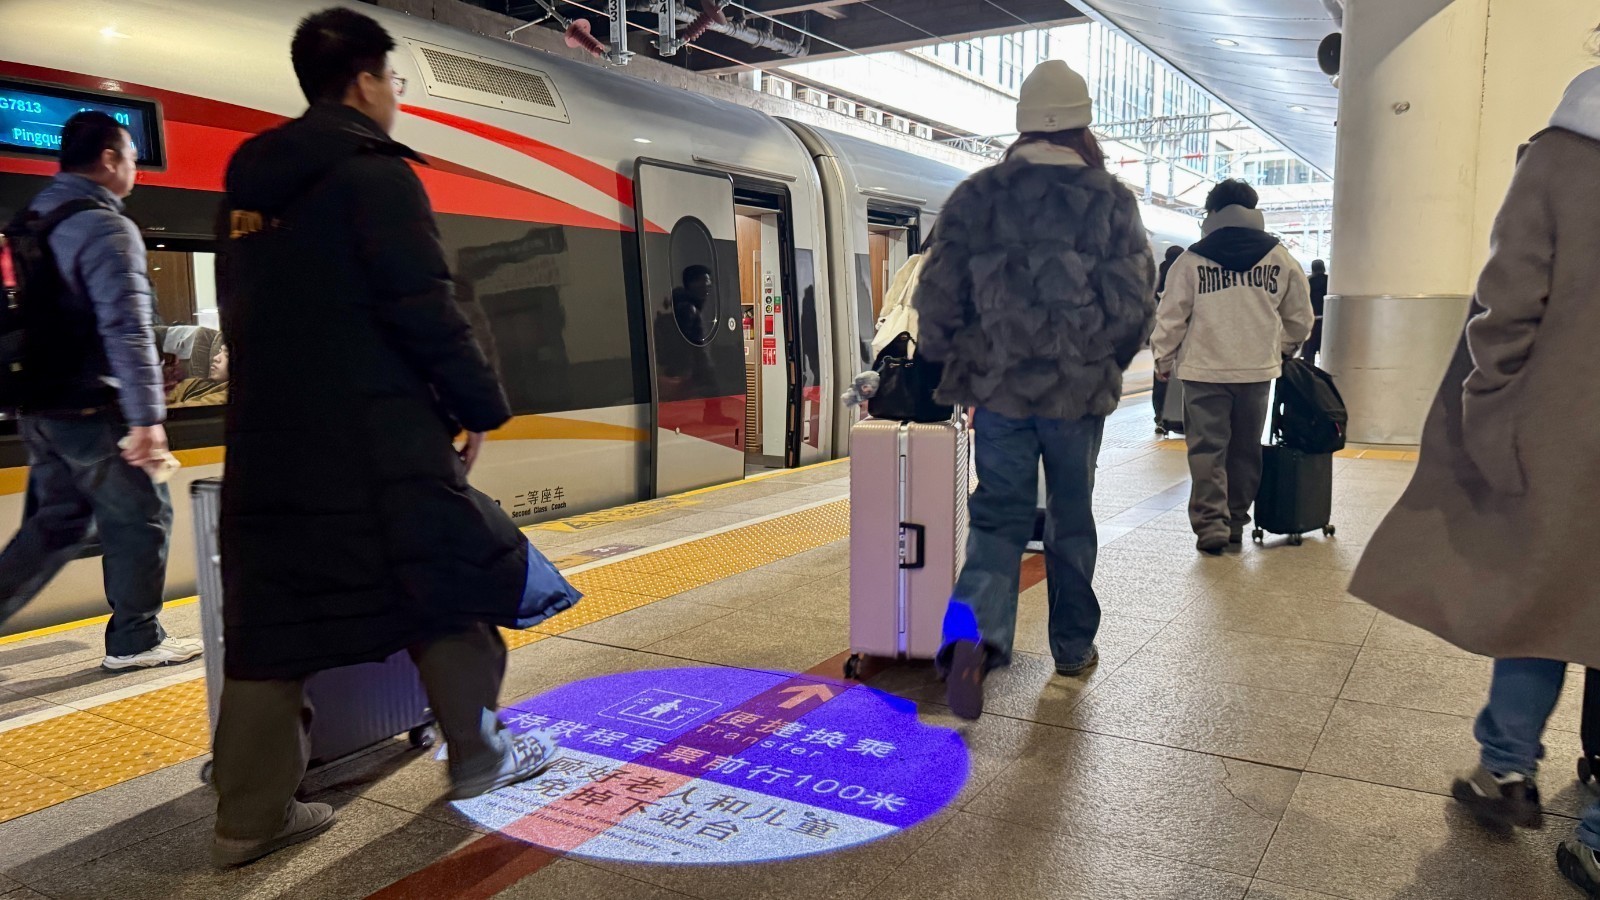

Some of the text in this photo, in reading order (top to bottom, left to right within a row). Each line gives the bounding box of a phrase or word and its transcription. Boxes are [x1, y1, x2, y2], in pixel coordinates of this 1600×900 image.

[0, 97, 42, 114] G7813
[13, 127, 63, 147] Pingqua
[1197, 264, 1281, 294] AMBITIOUS
[511, 501, 567, 518] Second Class Coach
[513, 486, 565, 507] 二等座车
[697, 723, 824, 758] Transfer
[714, 710, 897, 758] 便捷换乘
[522, 778, 740, 841] 免掉下站台
[548, 756, 840, 840] 顾好老人和儿童
